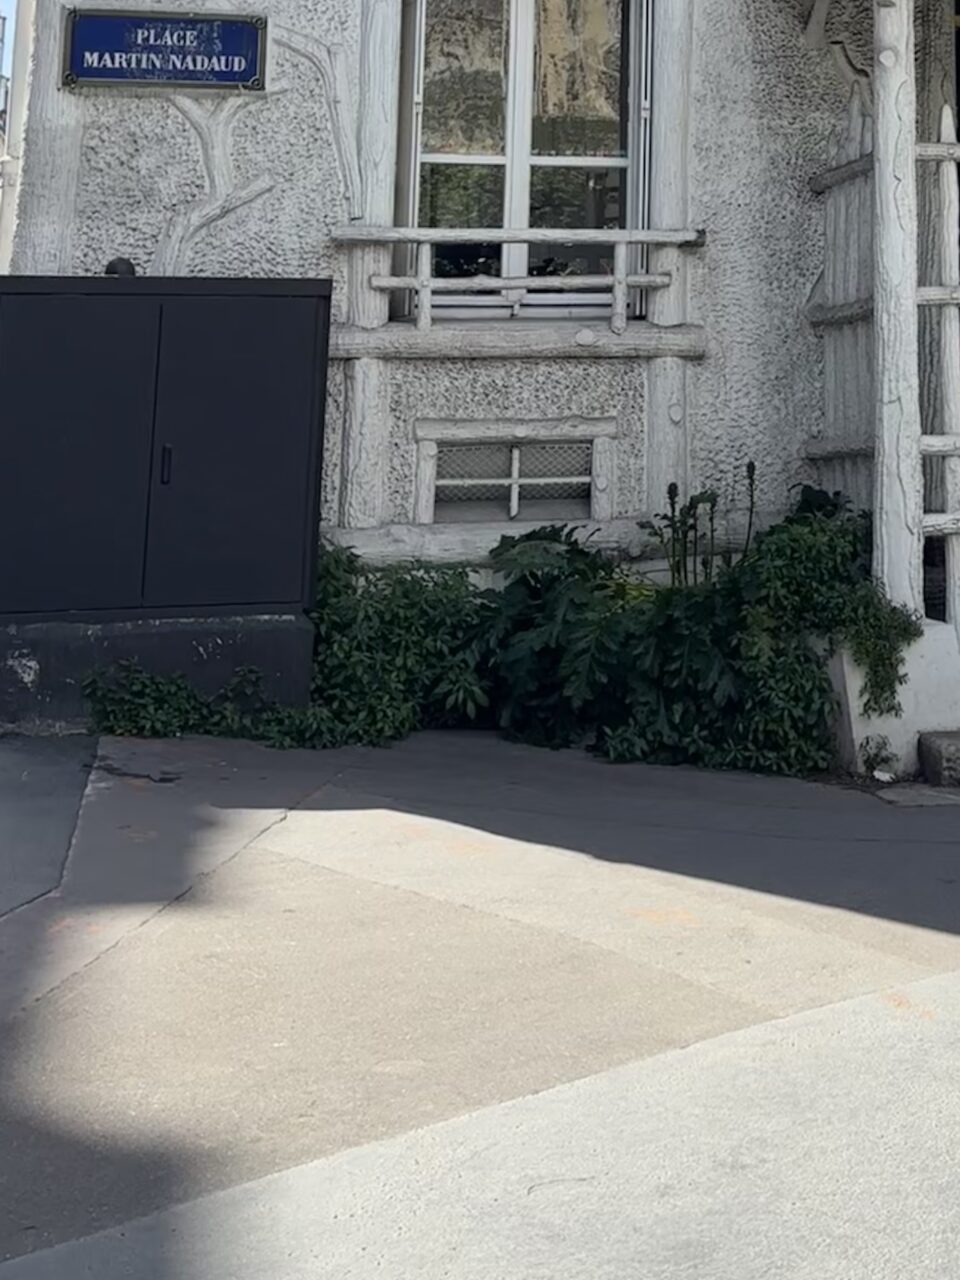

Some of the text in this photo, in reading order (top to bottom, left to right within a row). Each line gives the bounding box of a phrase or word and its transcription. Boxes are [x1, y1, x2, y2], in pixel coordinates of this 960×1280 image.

[136, 29, 198, 47] PLACE
[83, 51, 246, 73] MARTIN NADAUD
